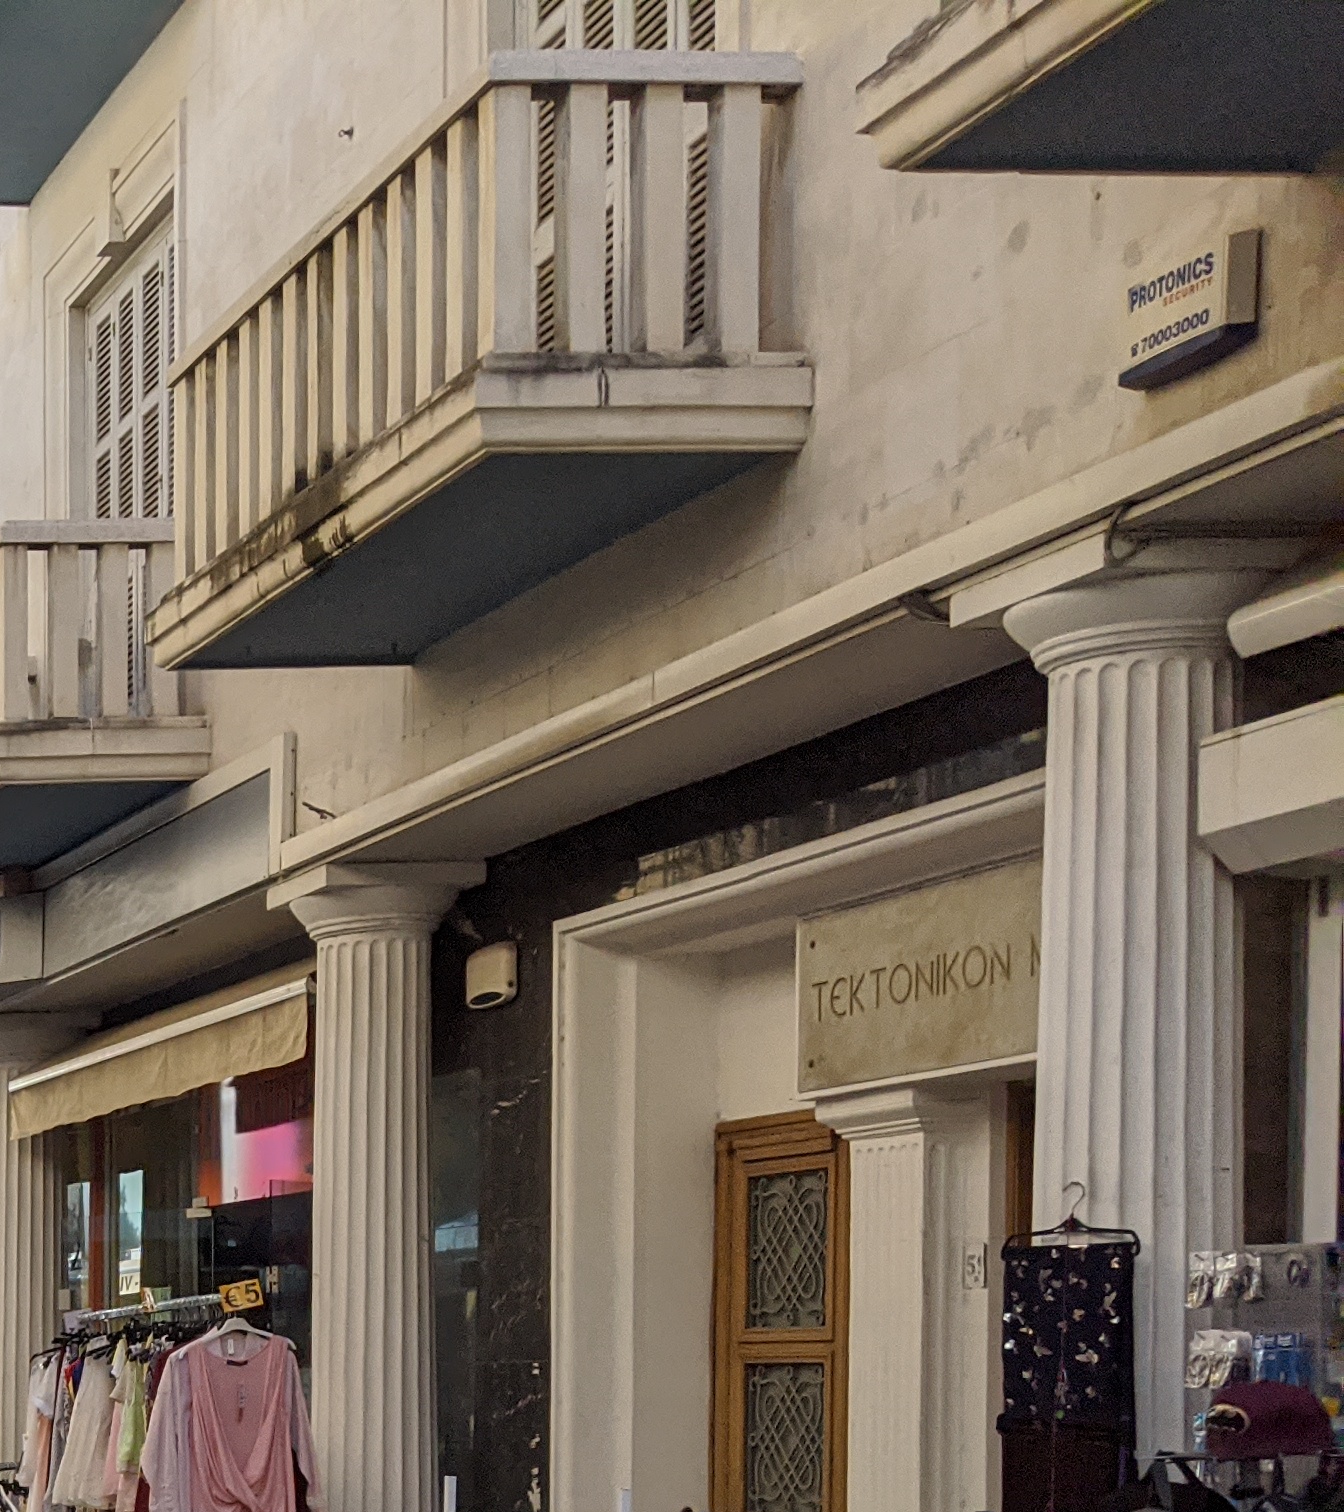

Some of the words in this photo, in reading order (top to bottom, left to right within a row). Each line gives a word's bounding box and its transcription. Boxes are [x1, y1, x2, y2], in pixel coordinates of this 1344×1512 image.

[1128, 251, 1214, 314] PROTONICS
[1162, 276, 1213, 307] SECURITY
[1140, 308, 1210, 354] 70003000
[223, 1281, 260, 1309] €5
